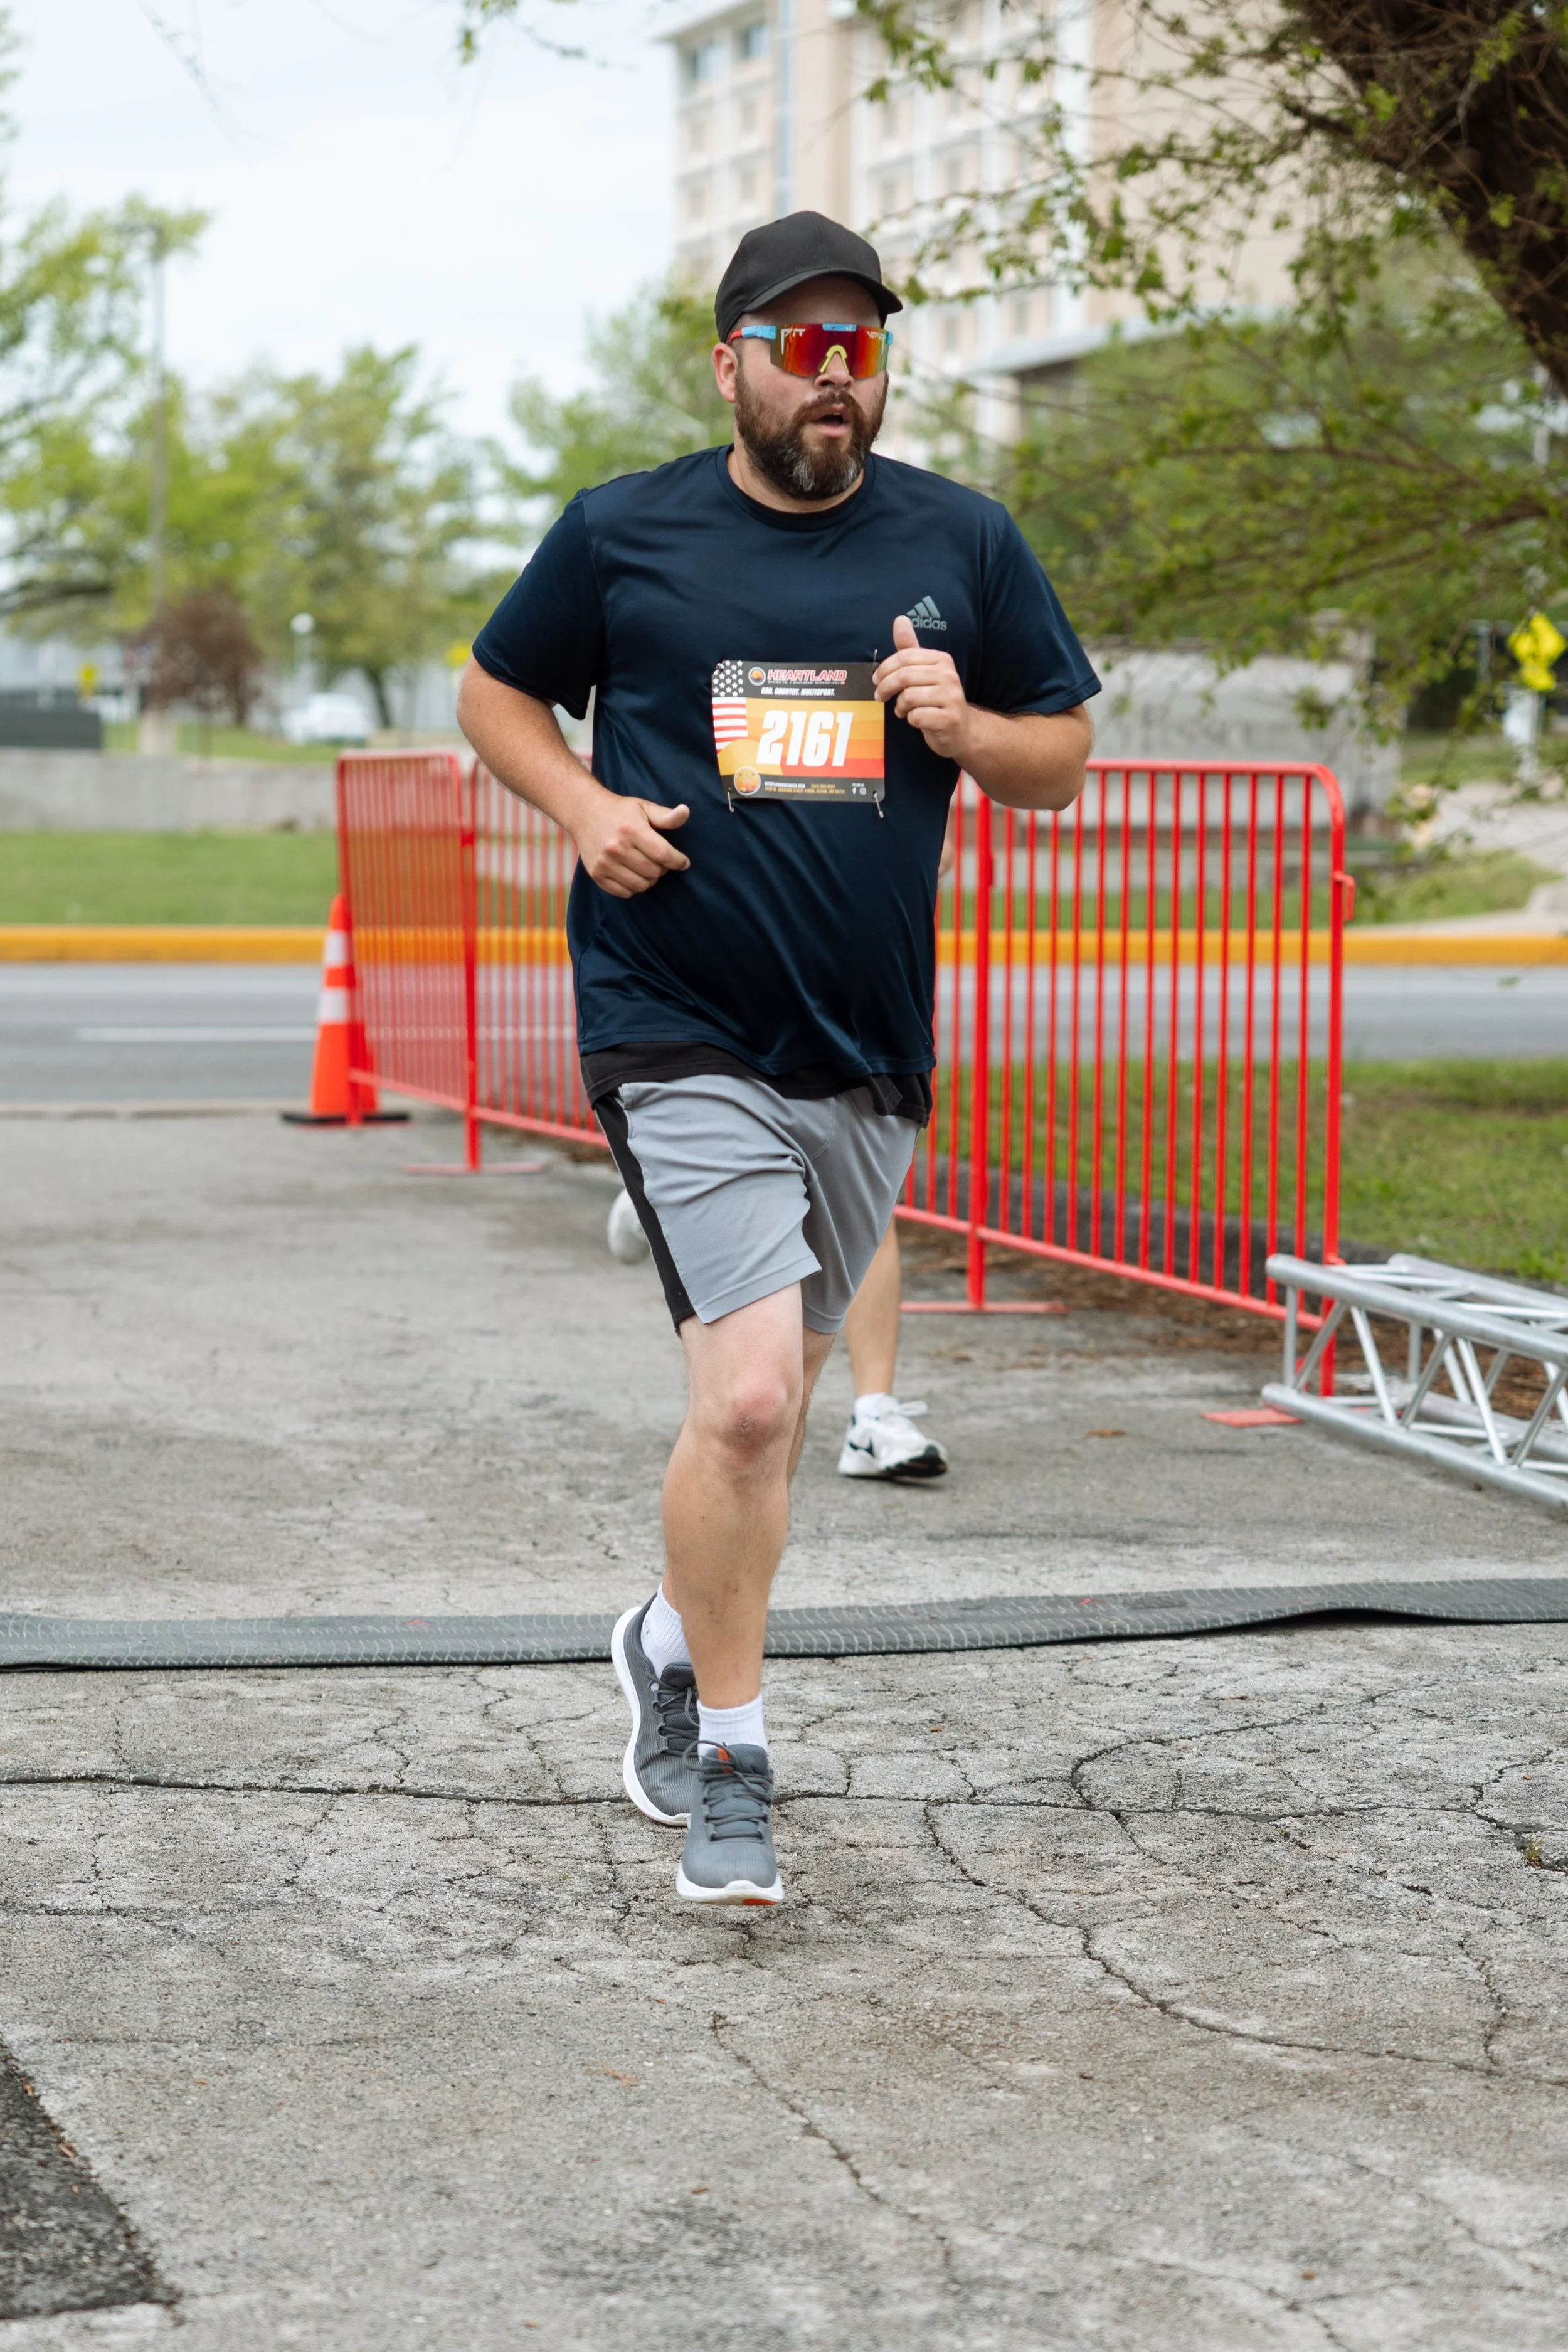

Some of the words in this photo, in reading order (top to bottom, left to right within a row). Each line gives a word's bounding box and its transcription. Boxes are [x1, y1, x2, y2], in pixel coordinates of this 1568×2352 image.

[911, 615, 948, 631] adidas
[767, 669, 847, 681] HEARTLAND
[756, 710, 854, 767] 2161
